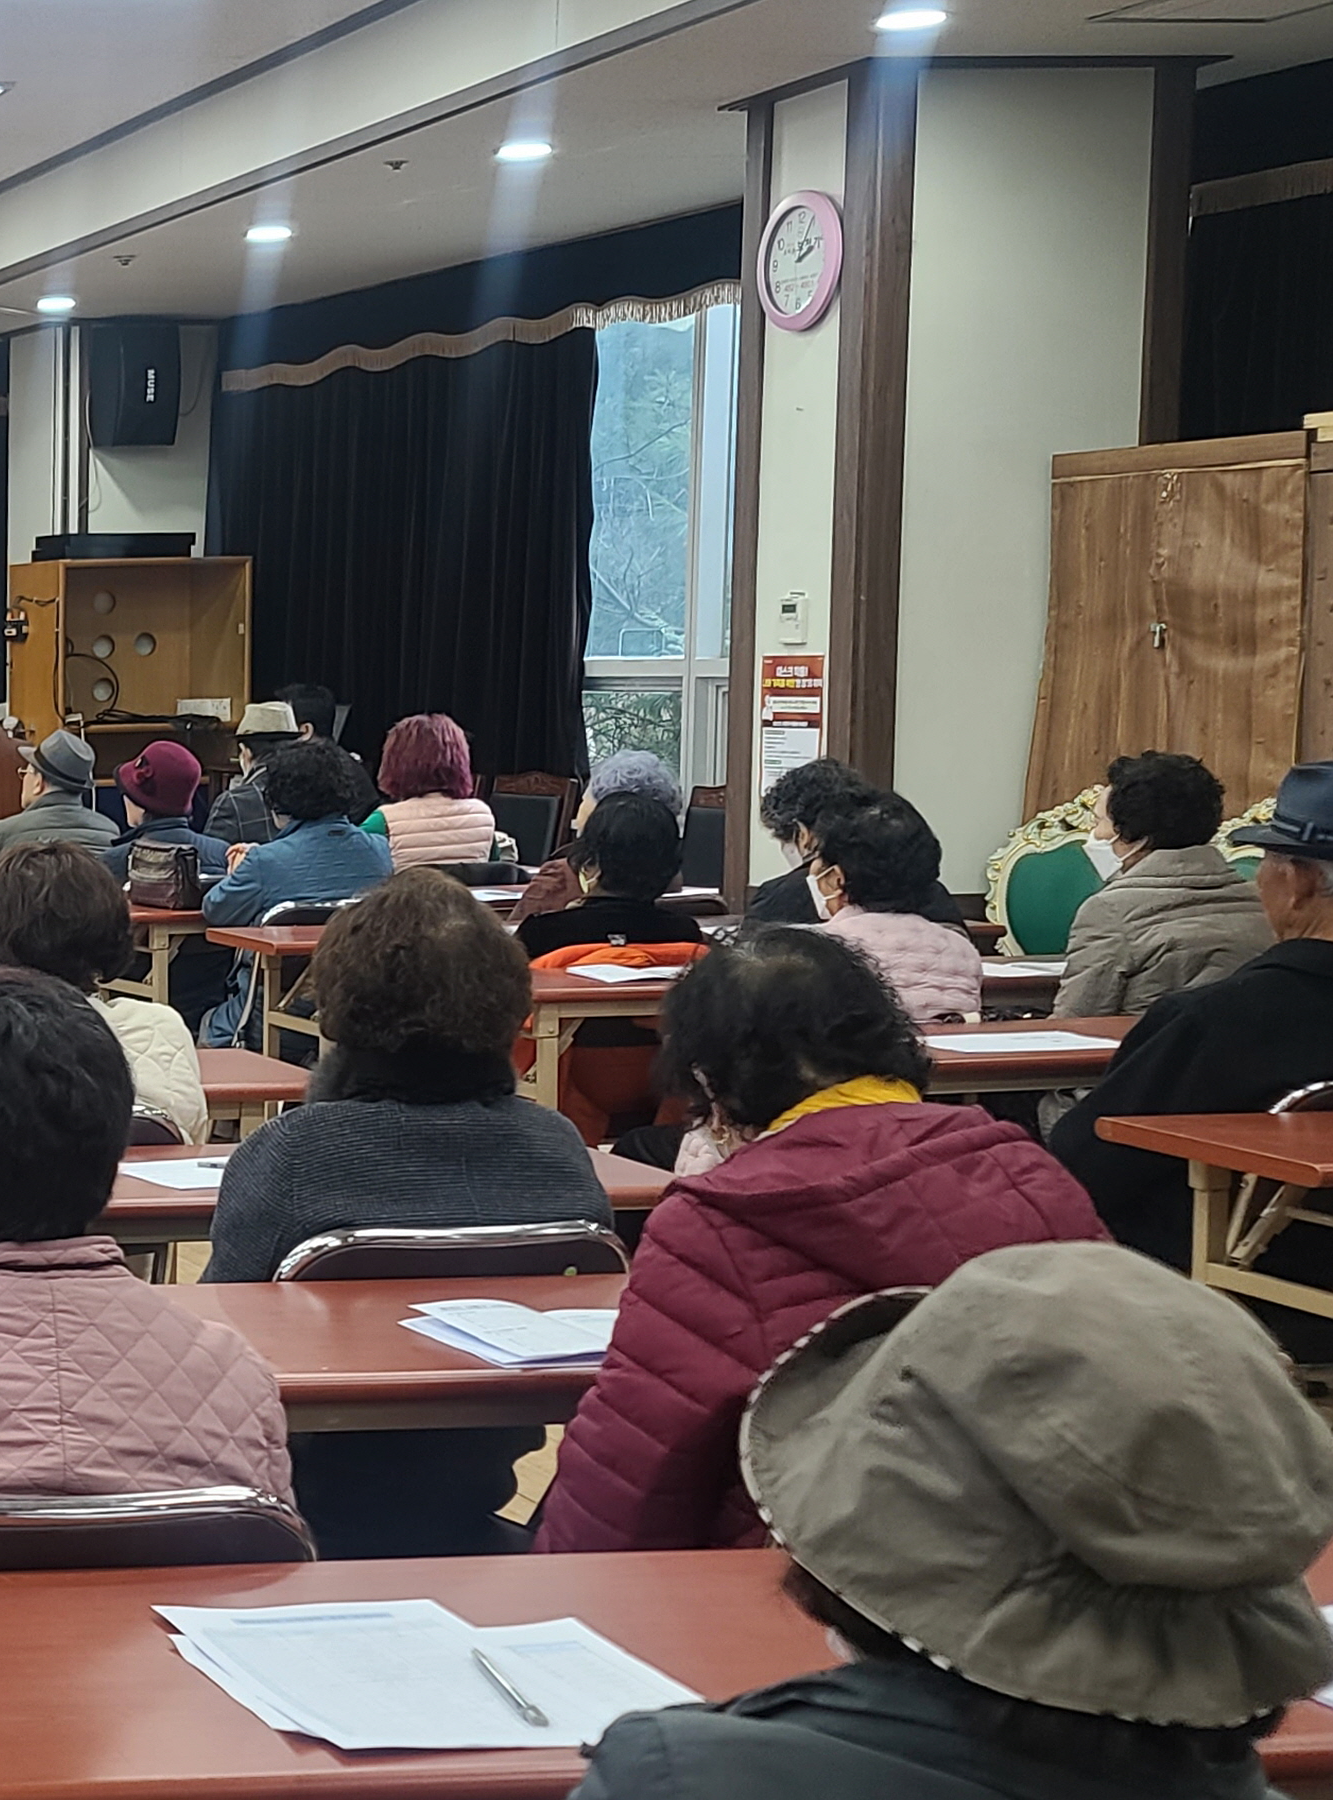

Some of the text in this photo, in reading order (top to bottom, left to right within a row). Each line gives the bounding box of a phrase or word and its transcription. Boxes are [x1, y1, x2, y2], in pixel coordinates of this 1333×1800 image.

[772, 260, 779, 273] 9
[775, 281, 781, 294] 8
[146, 368, 155, 403] MUSE
